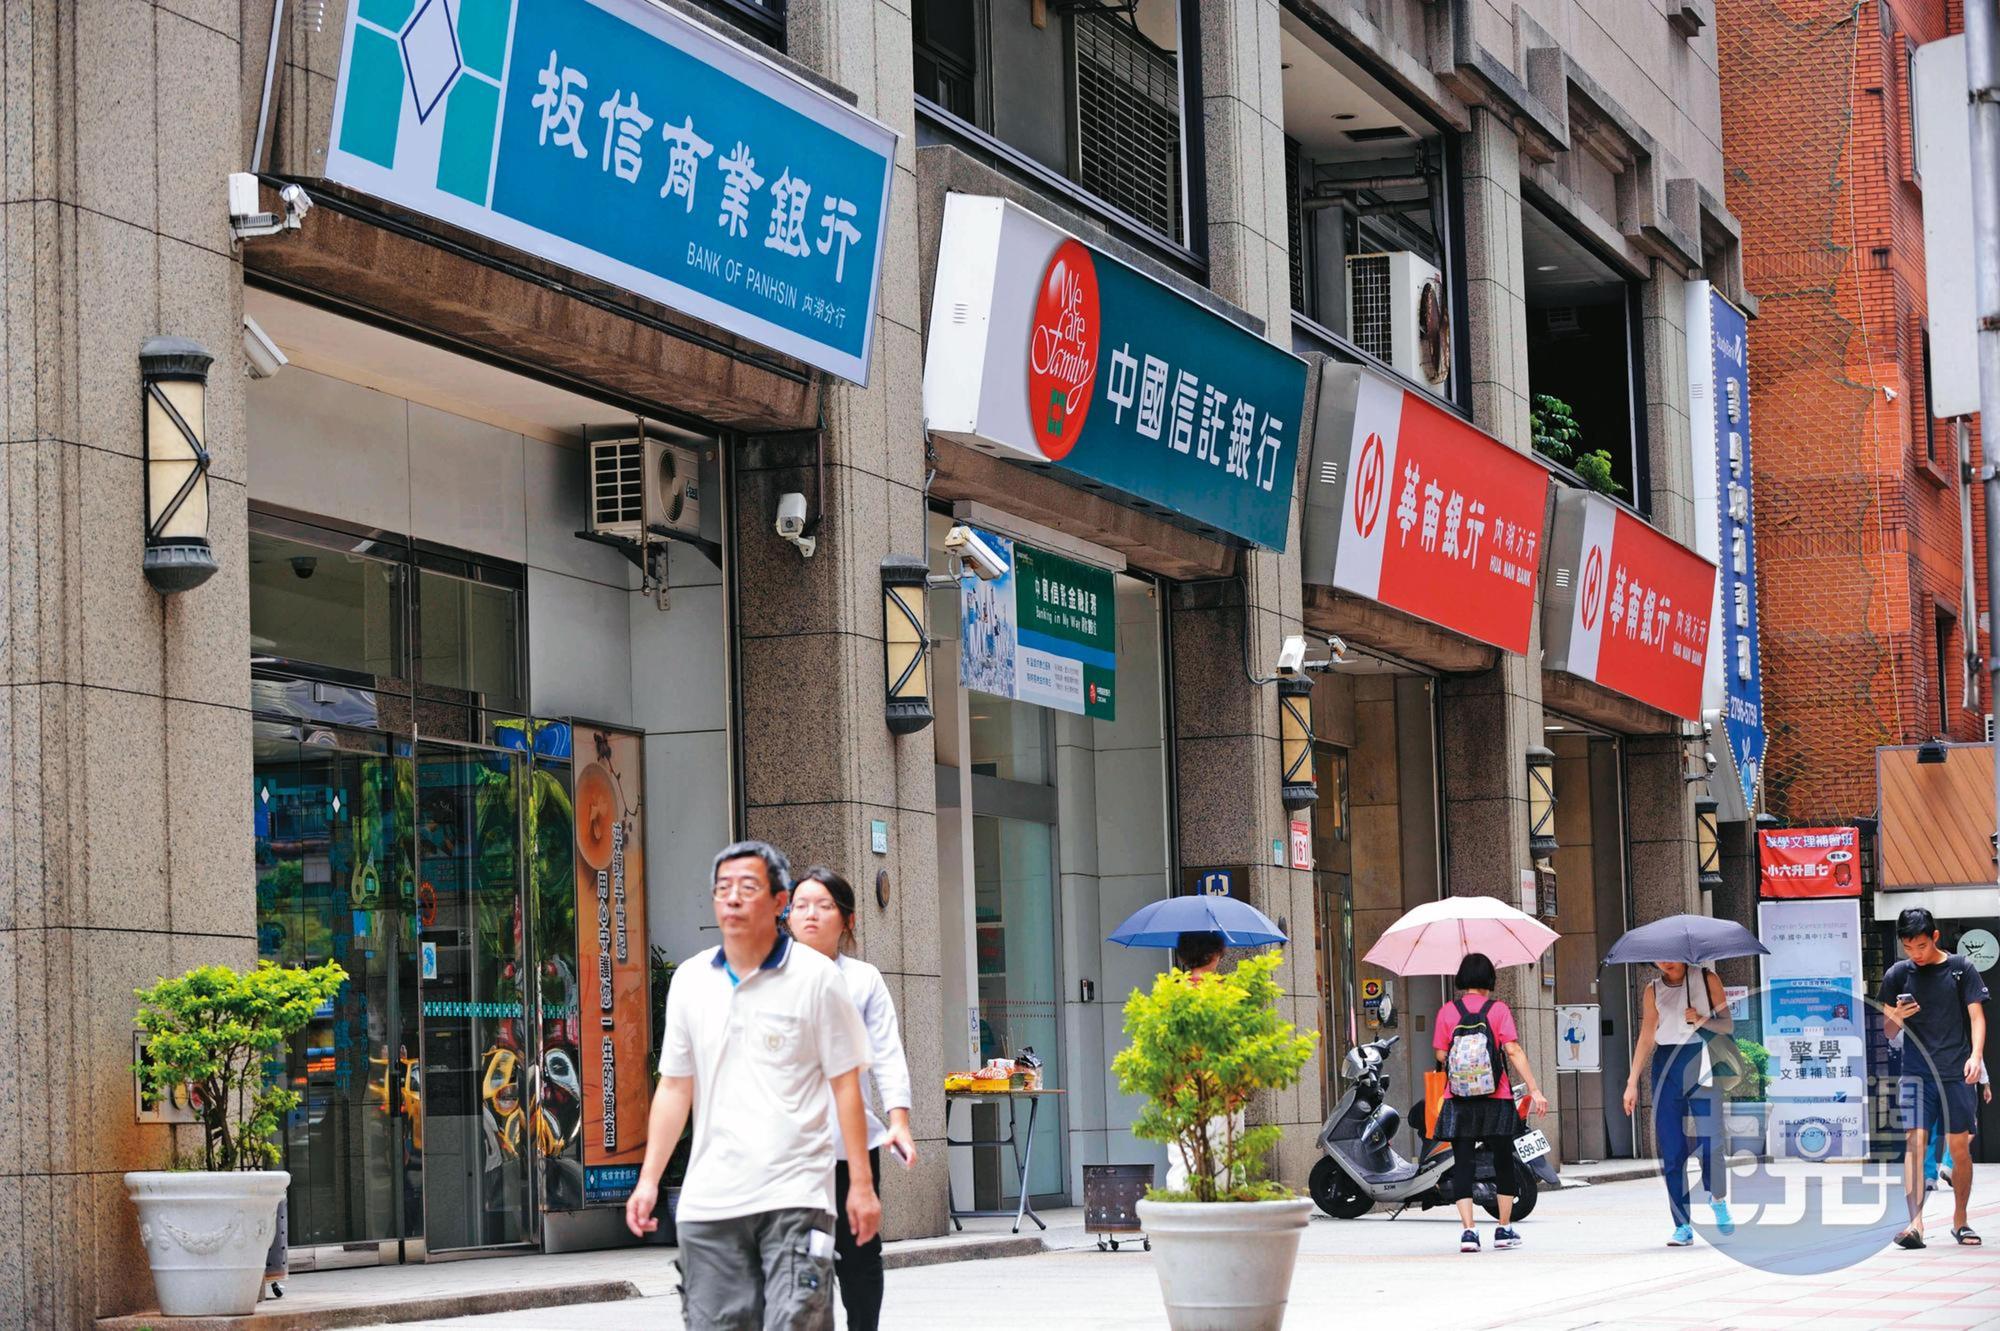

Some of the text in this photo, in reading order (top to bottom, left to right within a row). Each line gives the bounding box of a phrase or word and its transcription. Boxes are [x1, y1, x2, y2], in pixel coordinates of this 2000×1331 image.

[531, 49, 862, 284] 板信商業銀行
[687, 241, 798, 309] BANK OF PANHSIN
[1050, 260, 1083, 315] We
[802, 293, 847, 329] 內湖分行
[1106, 343, 1283, 491] 中國信託銀行
[1397, 458, 1485, 570] 華南銀行
[1489, 555, 1531, 587] HUA NAN BANK
[1610, 564, 1671, 653] 華南銀行
[1781, 1066, 1852, 1080] 文理補習班
[1790, 1040, 1841, 1064] 擎學
